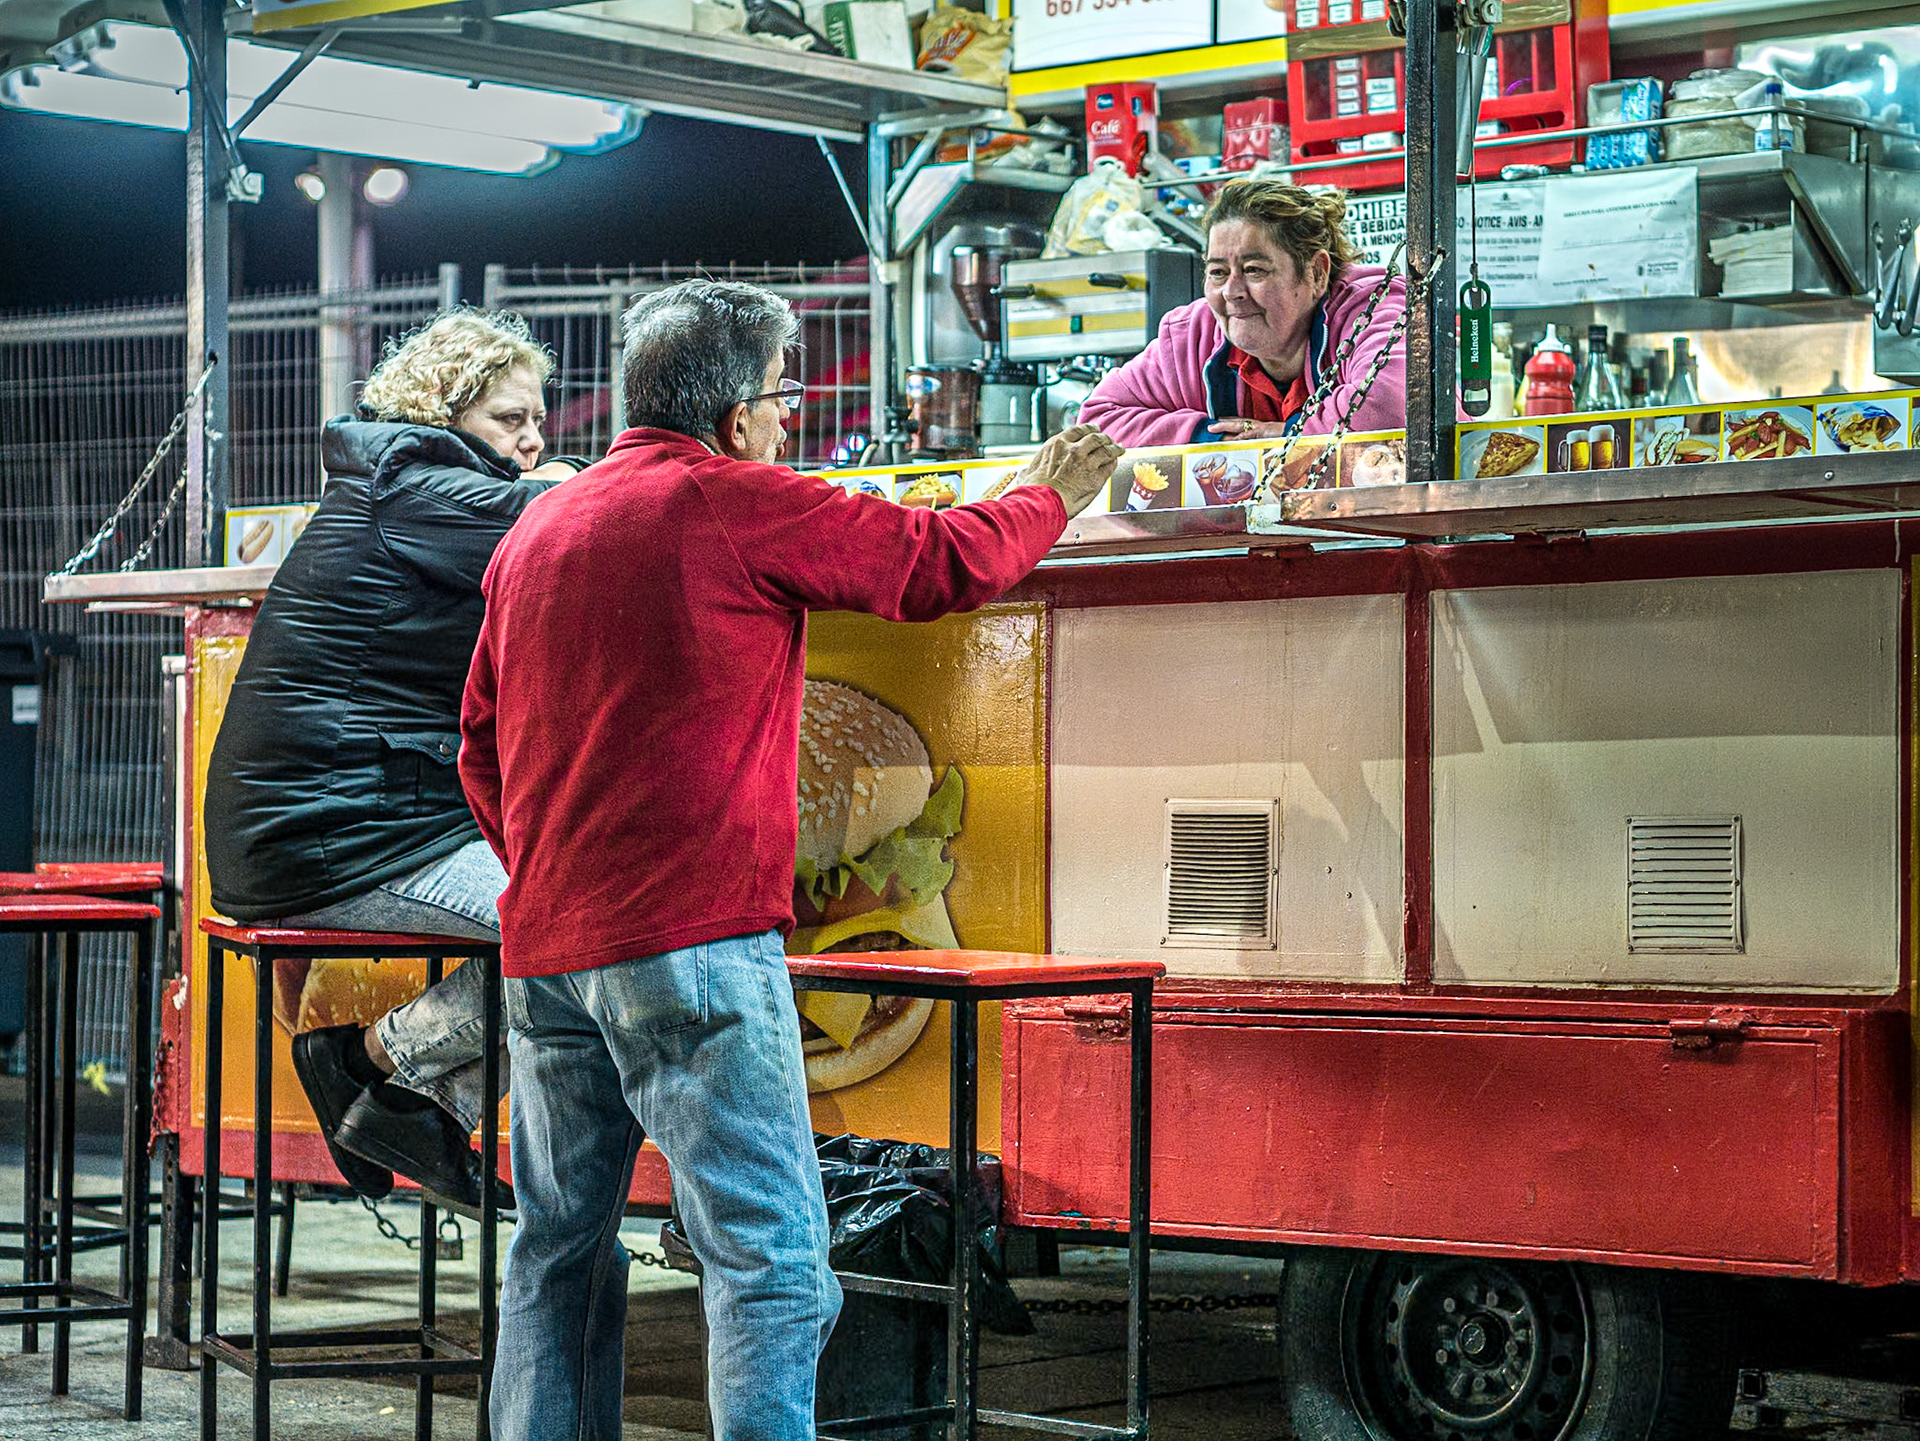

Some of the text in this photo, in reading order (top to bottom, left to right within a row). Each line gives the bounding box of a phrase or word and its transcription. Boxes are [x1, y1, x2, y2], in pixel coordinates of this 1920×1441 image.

[1090, 118, 1121, 136] Café
[1344, 200, 1407, 221] OHIBE
[1361, 217, 1405, 234] BEBIDA
[1507, 215, 1527, 228] AVIS
[1361, 236, 1367, 247] A
[1370, 232, 1406, 246] MENOR
[1470, 318, 1479, 363] Heineken
